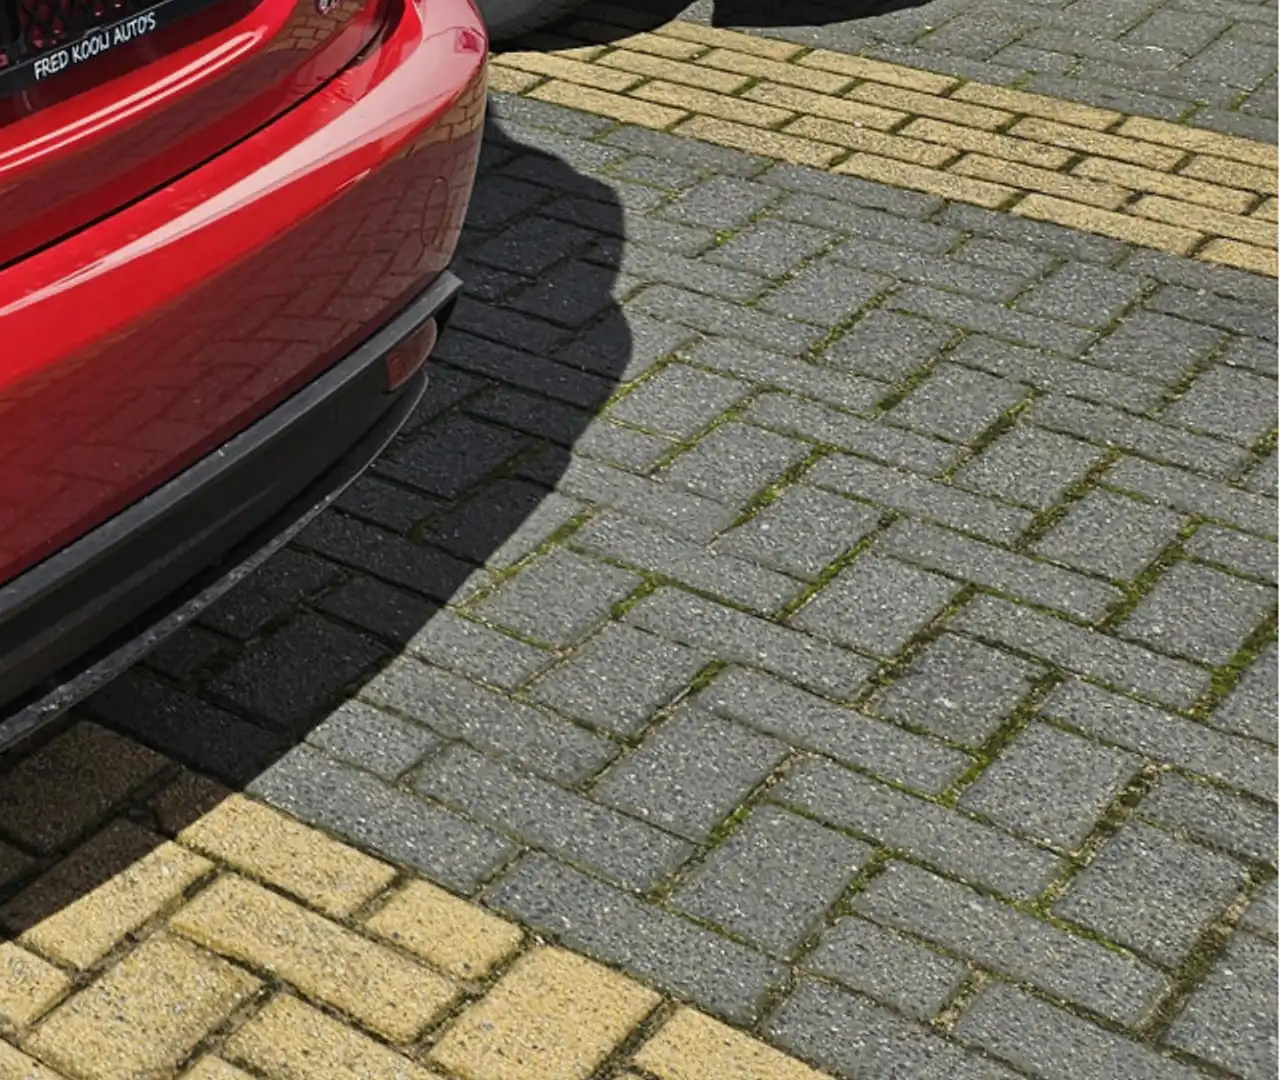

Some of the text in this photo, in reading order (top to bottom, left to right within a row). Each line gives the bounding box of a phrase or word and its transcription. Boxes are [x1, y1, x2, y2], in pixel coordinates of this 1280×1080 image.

[33, 11, 157, 81] FRED KOOIJ AUTO'S
